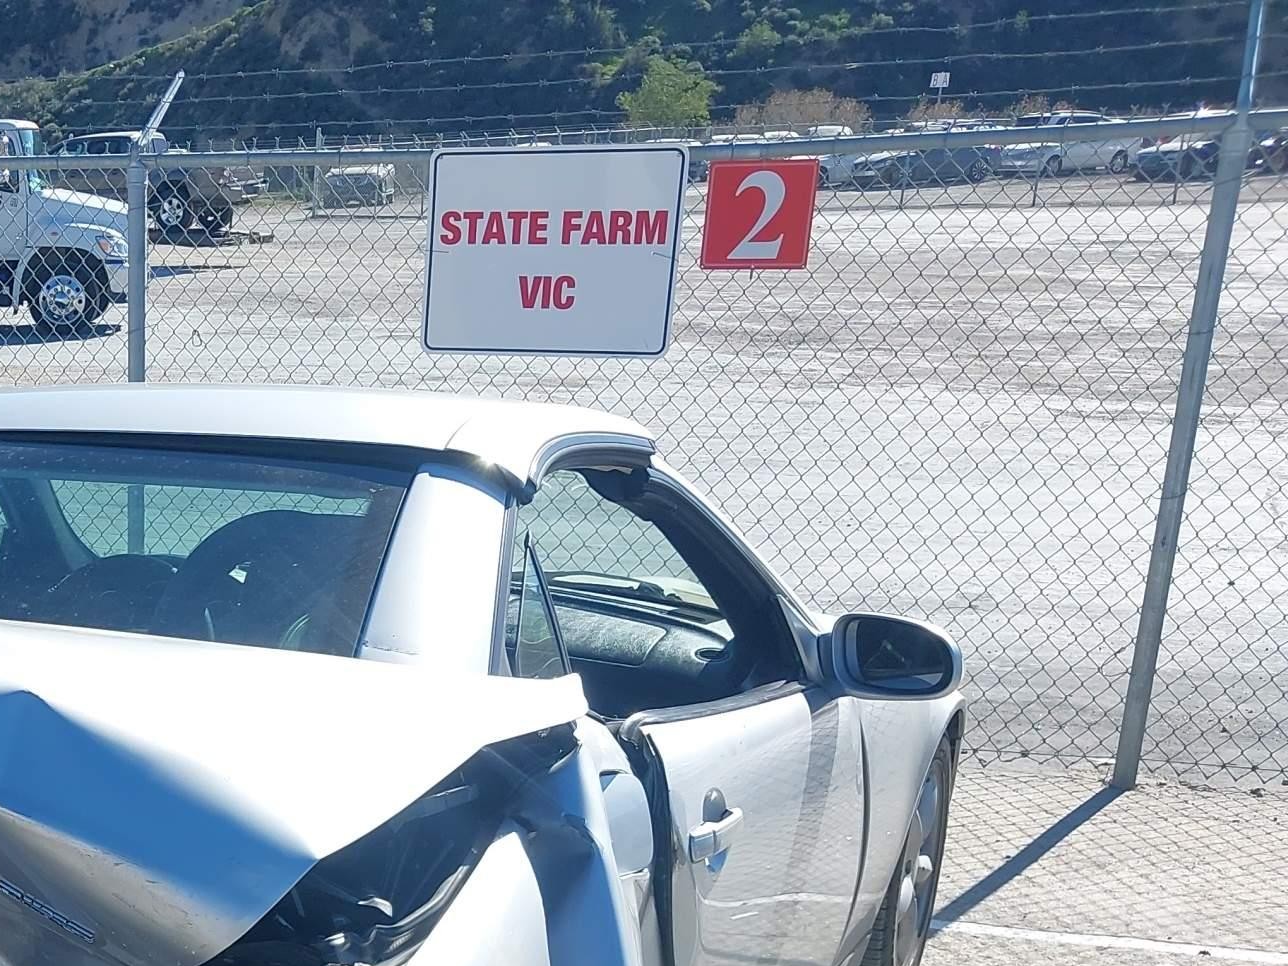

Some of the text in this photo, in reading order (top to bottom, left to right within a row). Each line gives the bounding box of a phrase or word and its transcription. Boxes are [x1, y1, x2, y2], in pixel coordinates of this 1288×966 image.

[439, 209, 669, 246] STATE FARM
[725, 169, 786, 260] 2
[518, 275, 576, 309] VIC
